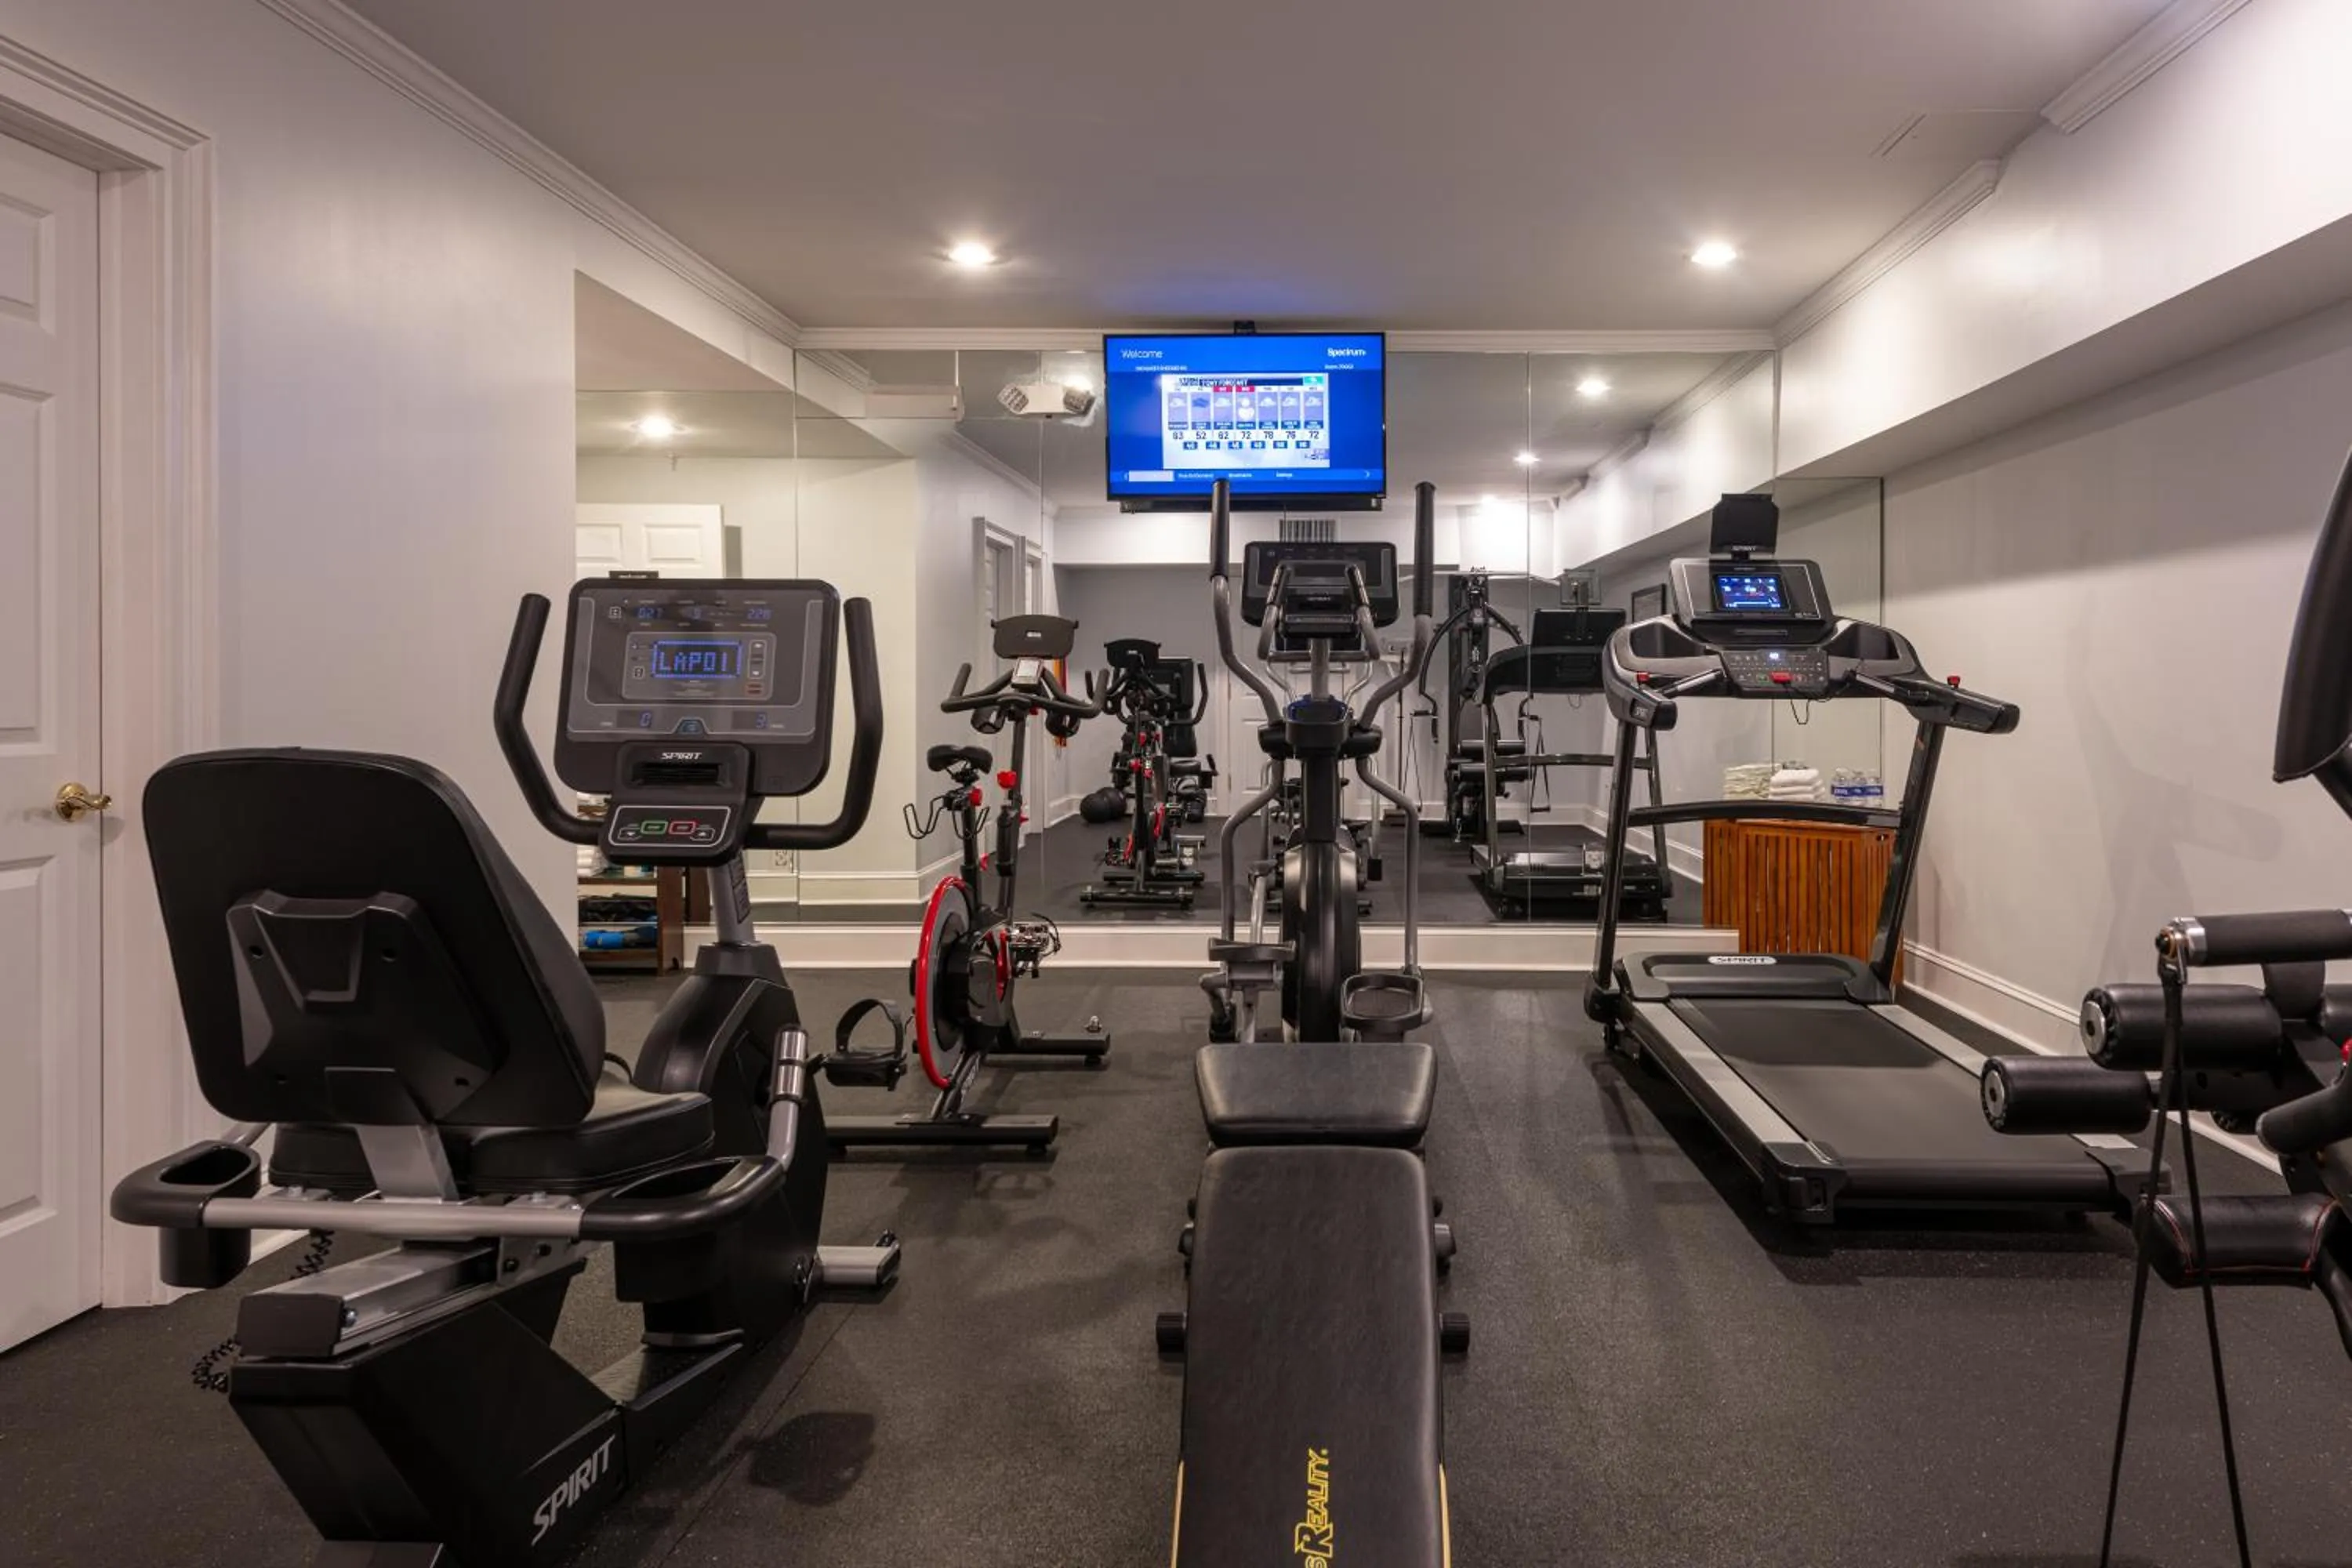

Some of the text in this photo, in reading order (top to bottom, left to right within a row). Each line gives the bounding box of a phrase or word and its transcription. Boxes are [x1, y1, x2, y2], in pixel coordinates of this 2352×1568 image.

[1121, 349, 1163, 359] Welcome
[1327, 348, 1367, 358] Spectrum
[531, 1433, 616, 1547] SPIRIT
